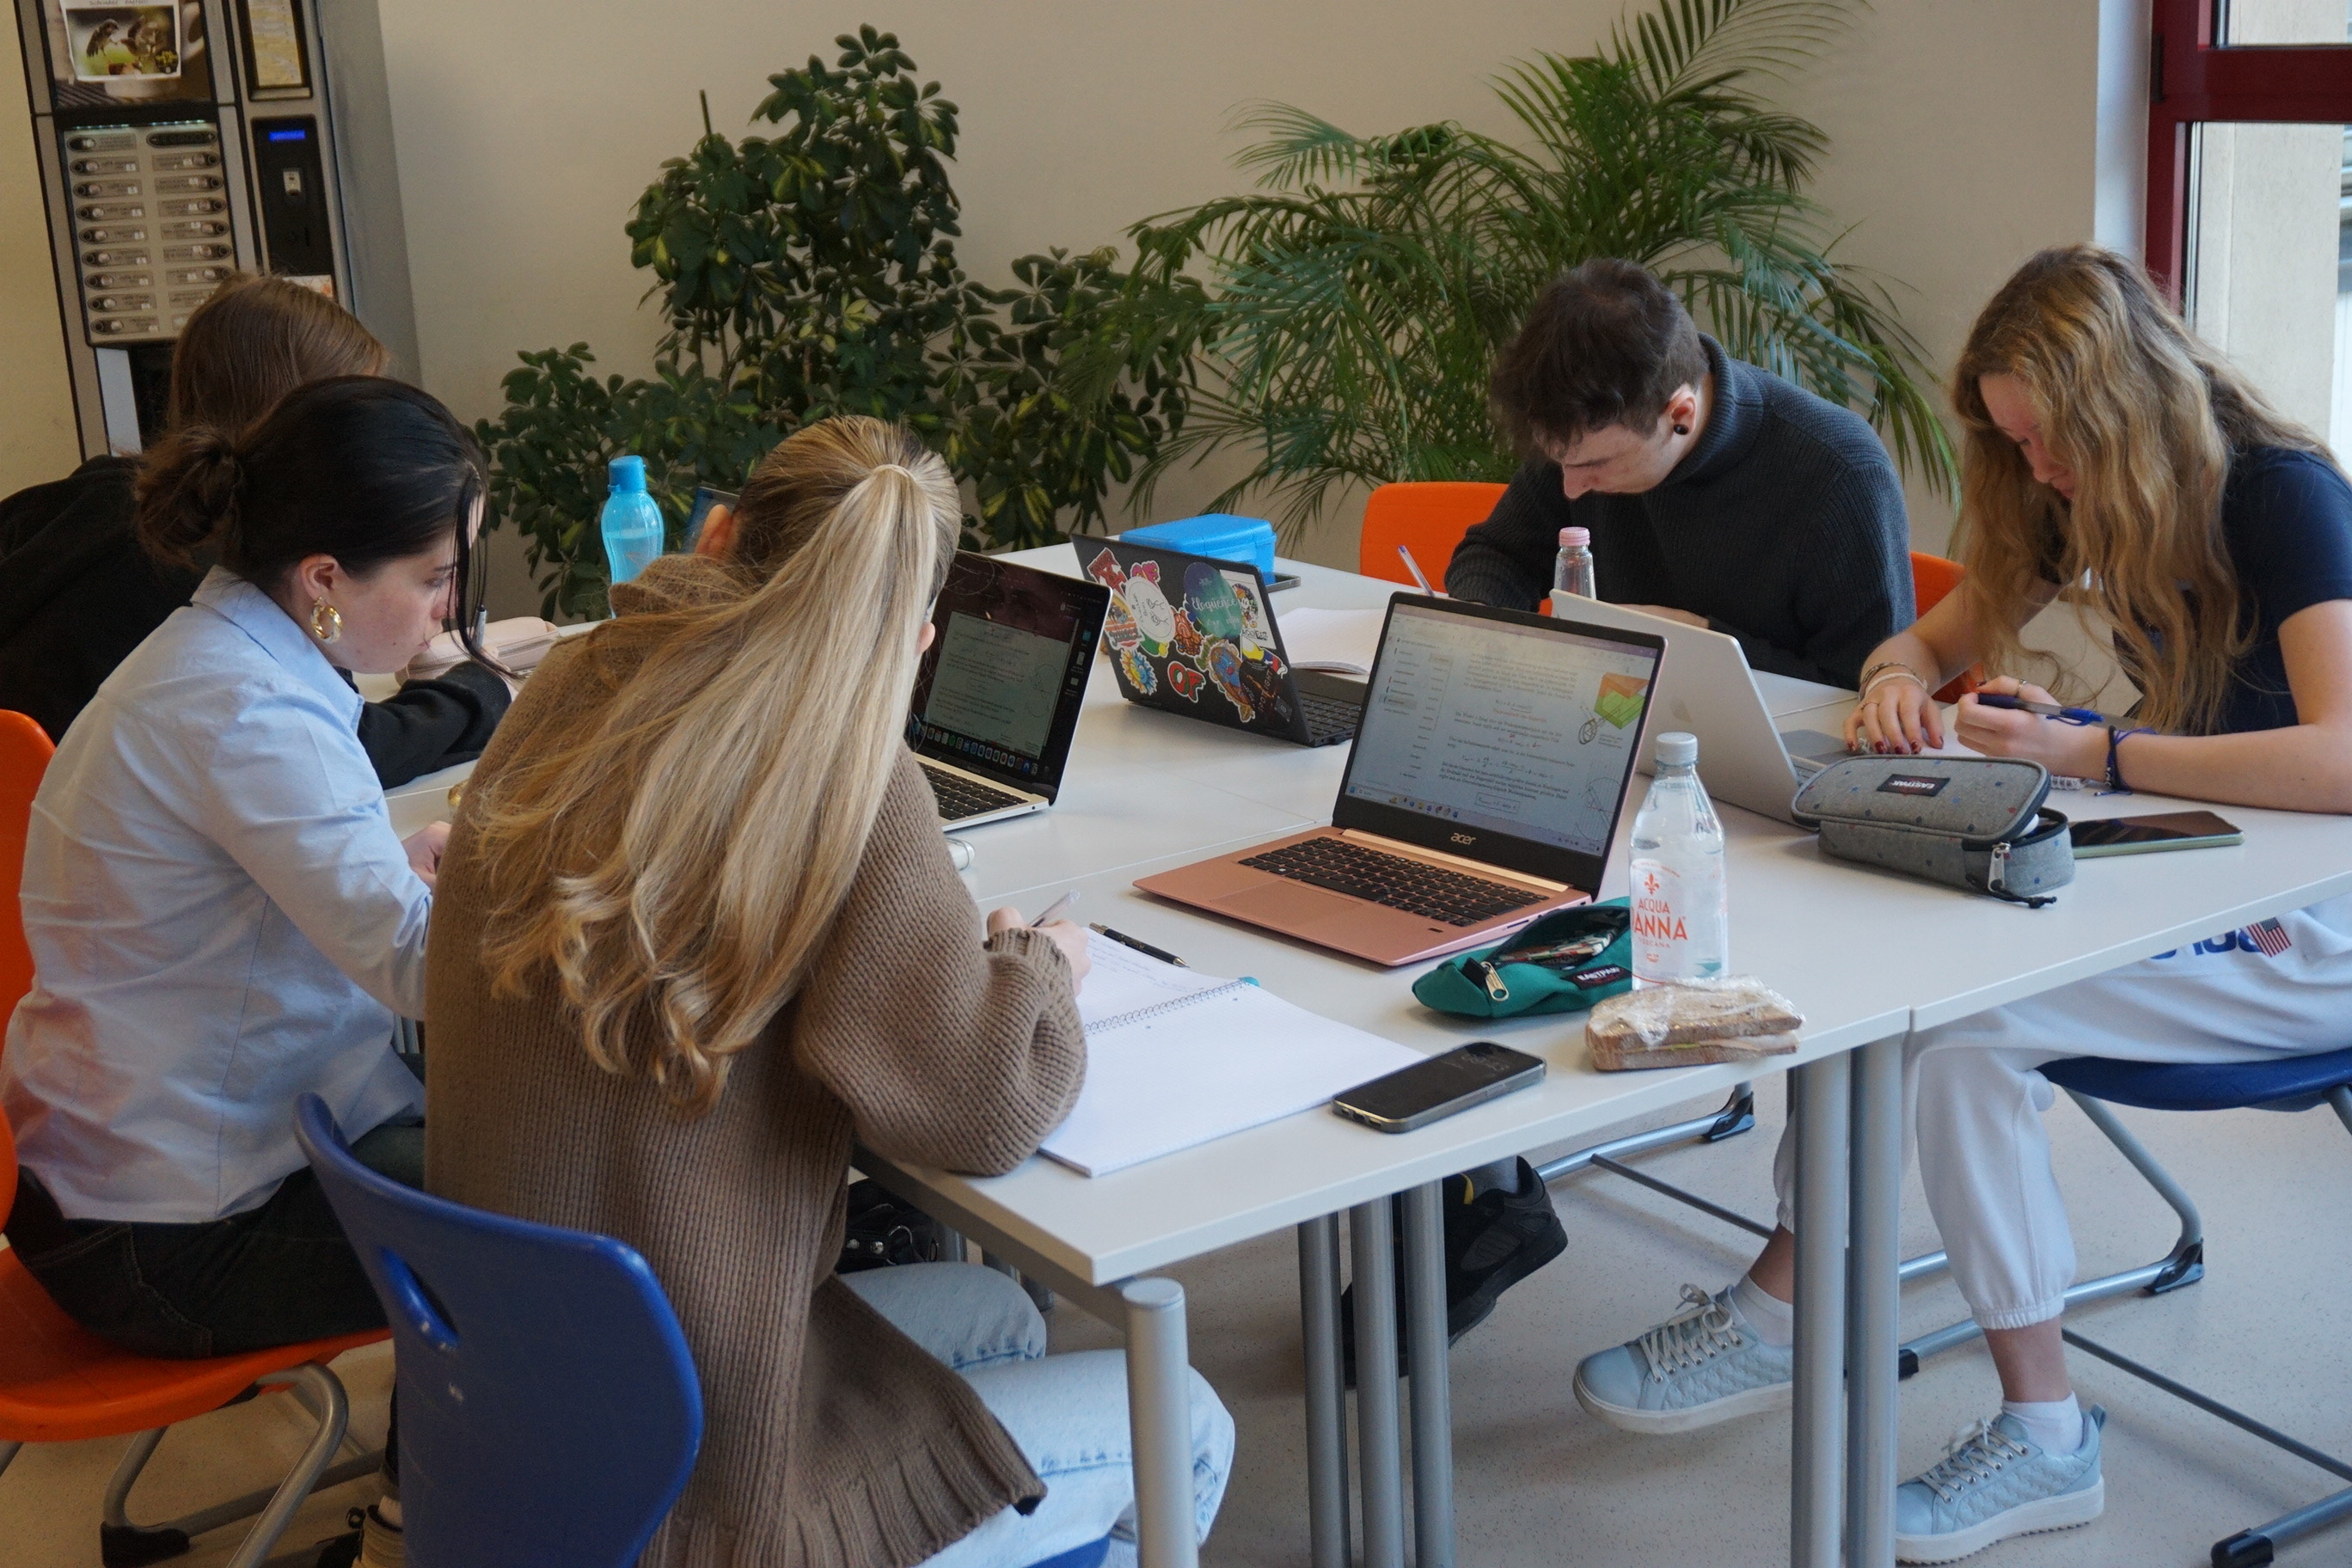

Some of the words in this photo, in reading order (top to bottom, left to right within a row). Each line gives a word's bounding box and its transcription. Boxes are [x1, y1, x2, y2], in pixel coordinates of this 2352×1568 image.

[1892, 780, 1935, 789] EASTPAK
[1450, 832, 1477, 846] acer
[1638, 897, 1670, 914] ACQUA
[1577, 966, 1620, 981] EASTPAK
